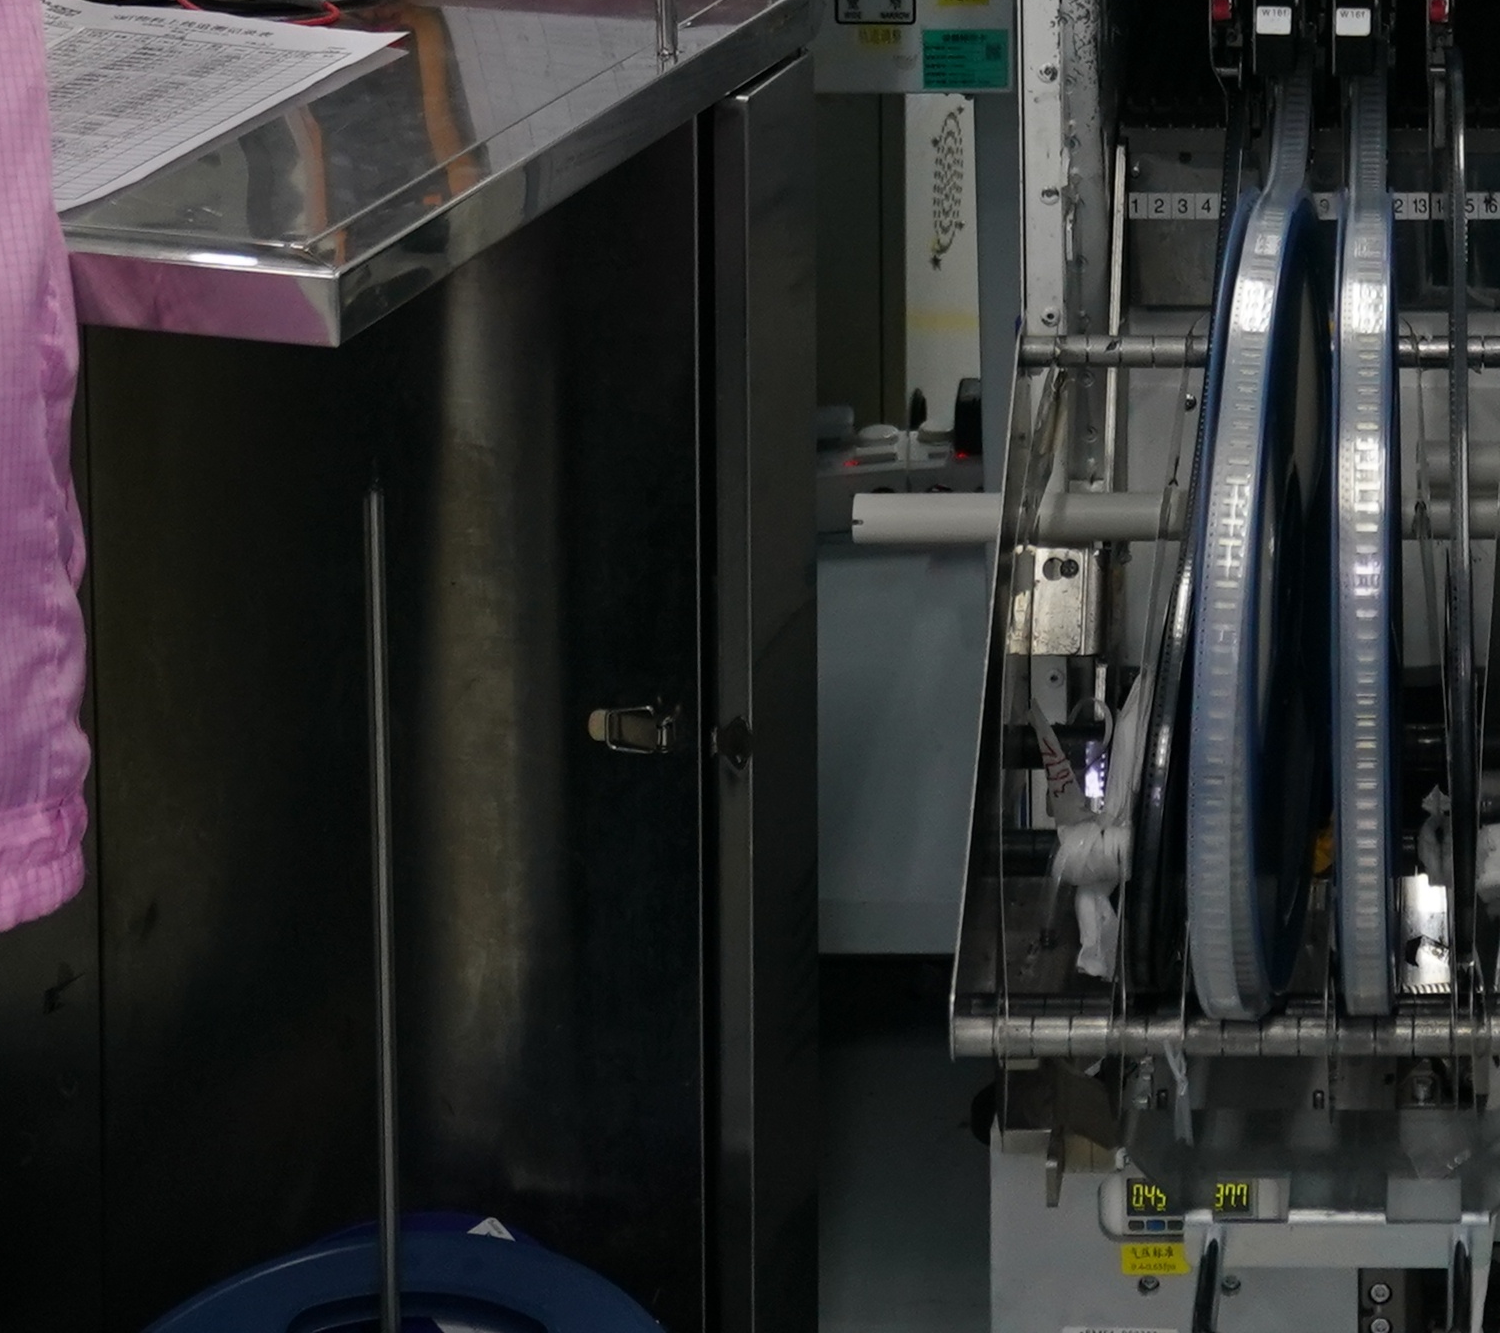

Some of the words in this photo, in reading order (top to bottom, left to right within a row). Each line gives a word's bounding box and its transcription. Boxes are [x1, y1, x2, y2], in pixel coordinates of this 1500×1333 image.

[1131, 199, 1140, 214] 1
[1154, 199, 1165, 214] 2
[1177, 199, 1188, 214] 3
[1201, 199, 1212, 214] 4
